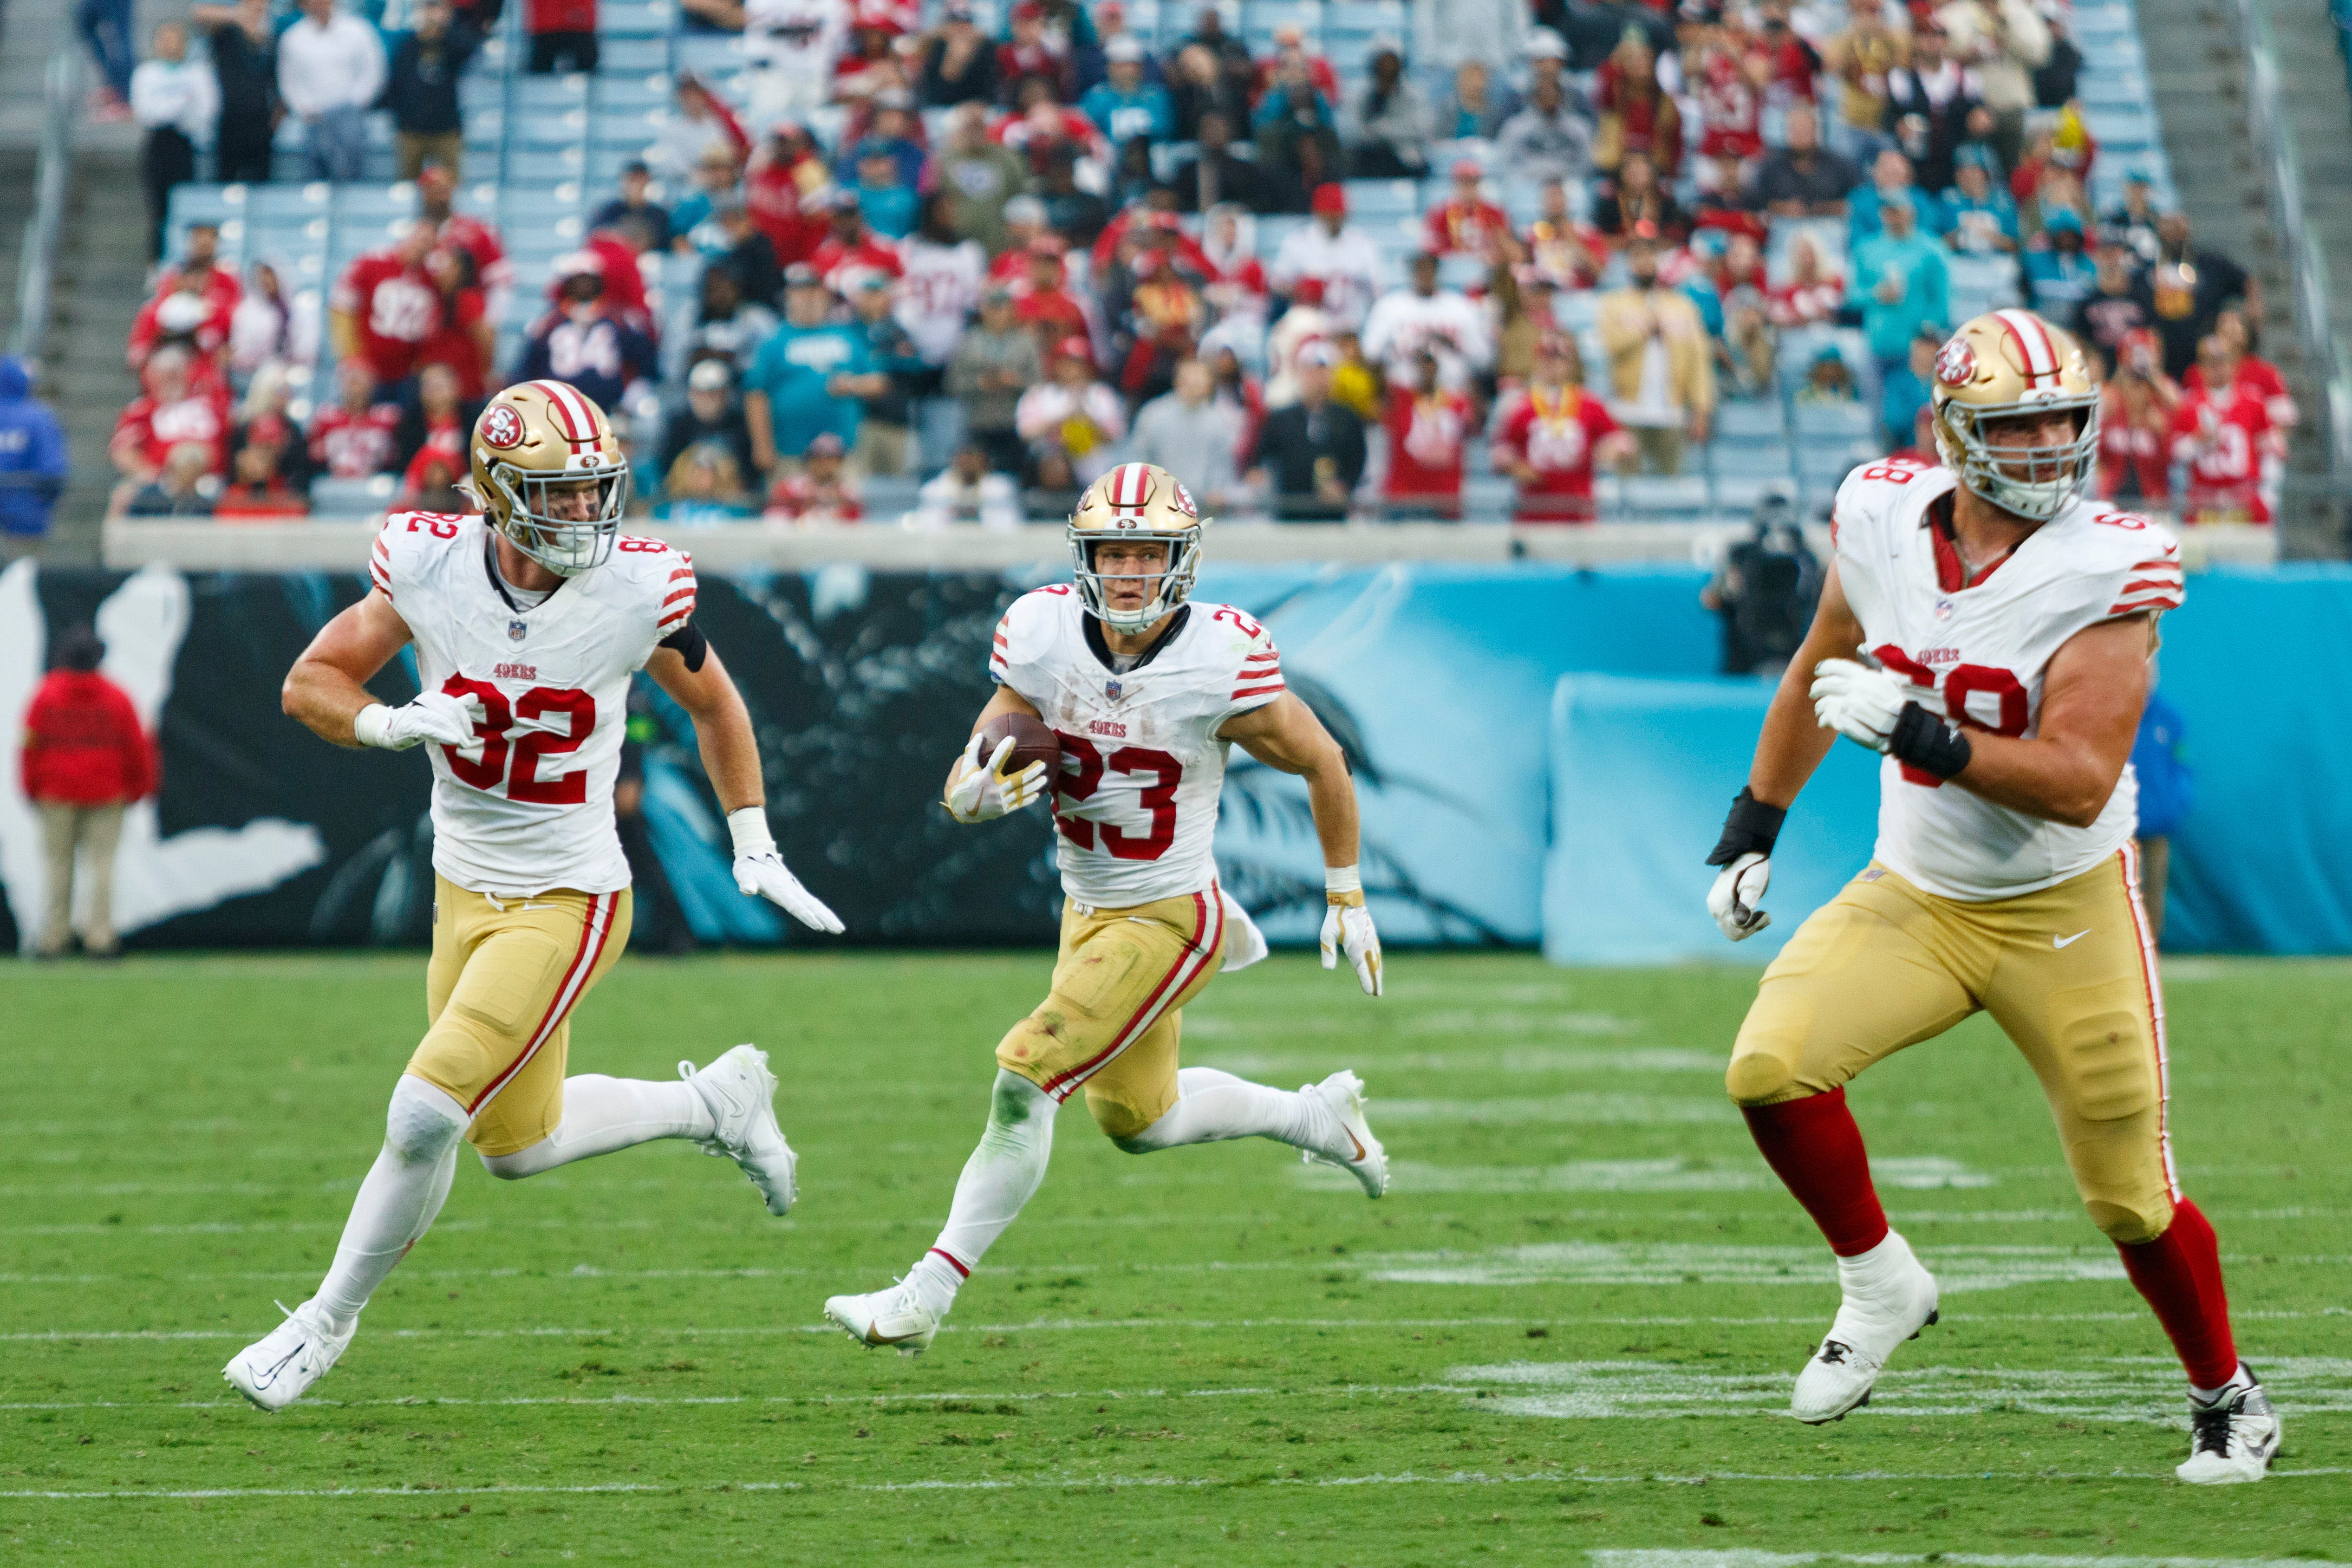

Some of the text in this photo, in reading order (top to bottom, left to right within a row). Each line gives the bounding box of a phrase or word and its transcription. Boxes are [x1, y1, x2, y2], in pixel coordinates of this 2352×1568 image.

[486, 408, 515, 443] SF
[494, 663, 536, 680] 49ERS
[1089, 720, 1126, 738] 49ERS
[1050, 728, 1183, 861] 23
